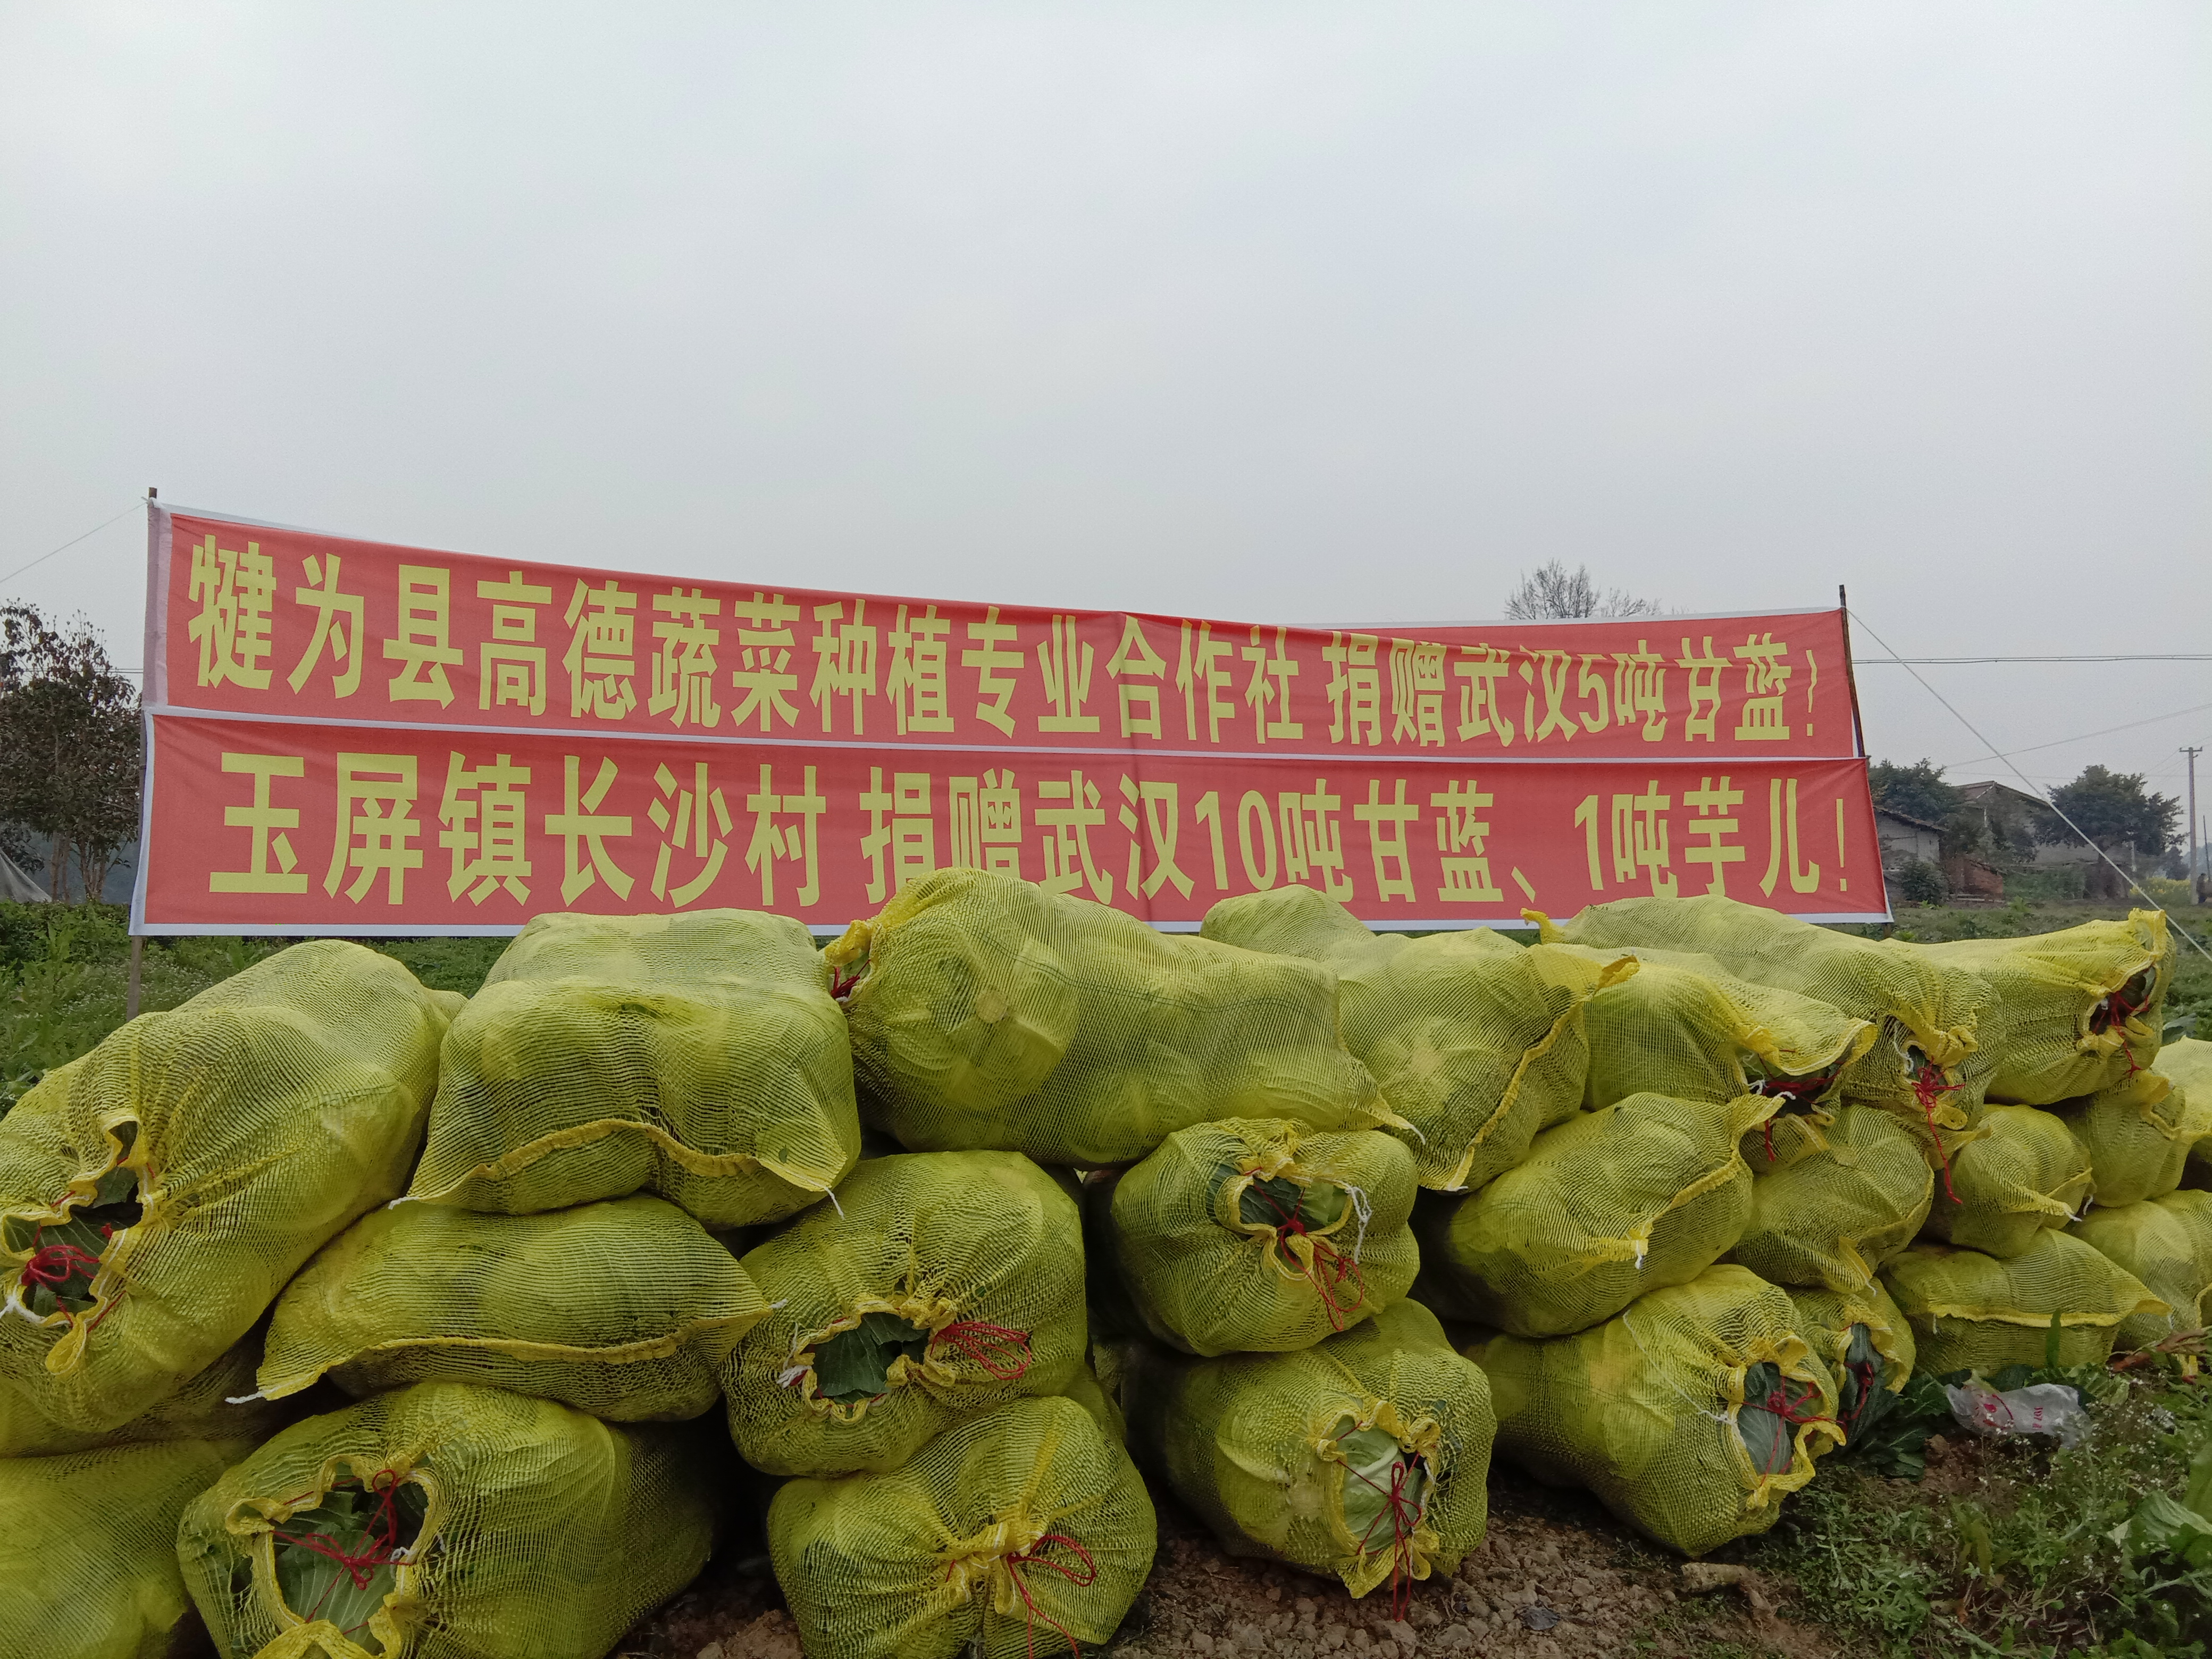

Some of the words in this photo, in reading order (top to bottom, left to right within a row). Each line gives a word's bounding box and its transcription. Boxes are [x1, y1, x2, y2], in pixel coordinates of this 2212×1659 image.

[188, 534, 1303, 744] 犍为县高德蔬菜种植专业合作社
[210, 751, 826, 908] 玉屏镇长沙村
